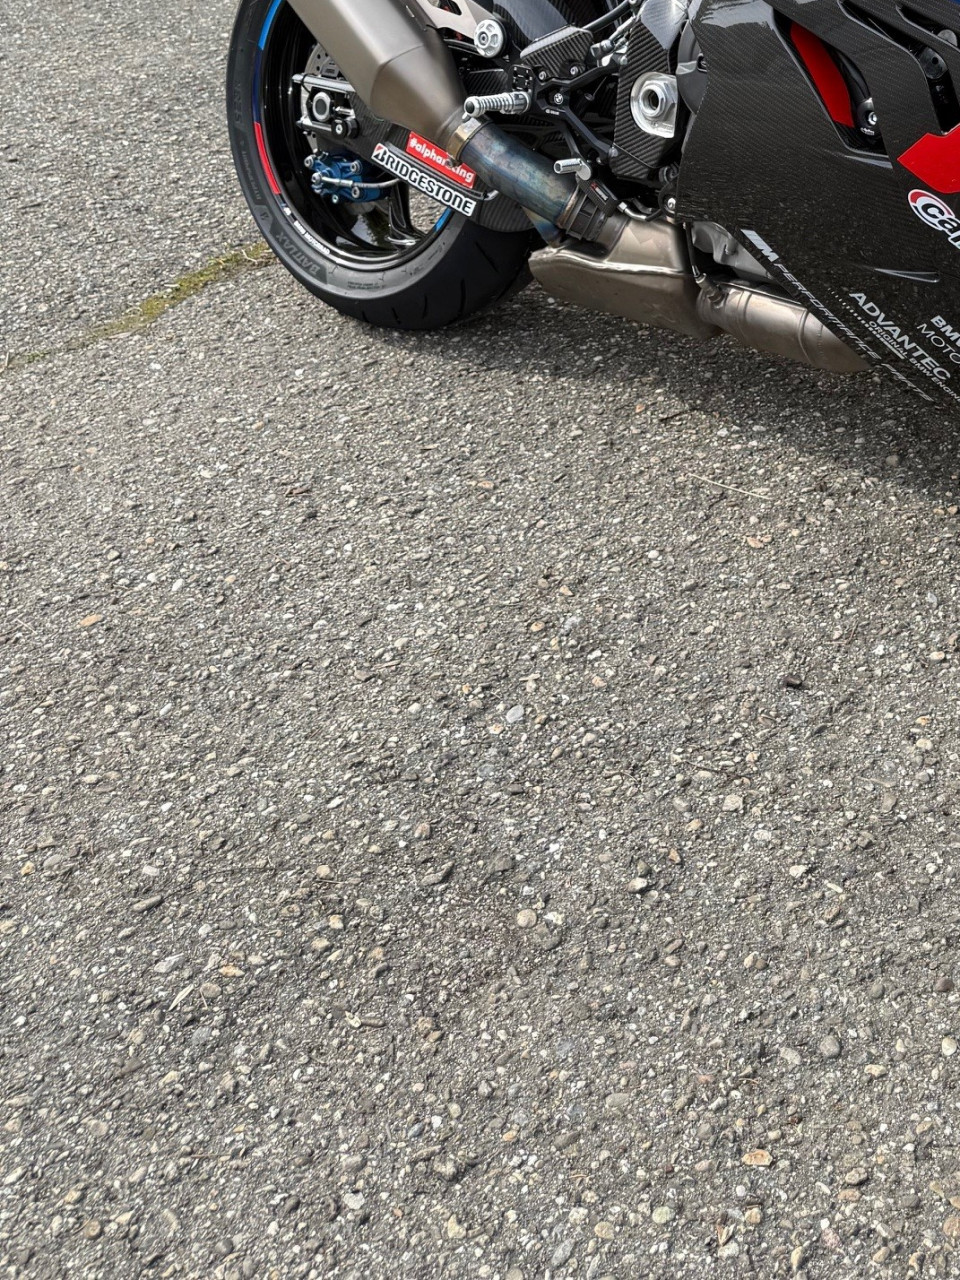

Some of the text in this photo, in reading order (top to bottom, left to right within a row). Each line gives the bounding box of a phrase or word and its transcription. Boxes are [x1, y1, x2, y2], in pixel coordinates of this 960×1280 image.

[373, 144, 474, 216] BRIDGESTONE
[409, 137, 475, 183] #alpharing
[773, 263, 882, 360] PERFORMANCE
[881, 363, 934, 401] PARTS
[849, 292, 951, 380] ADVANTEC
[868, 321, 908, 357] ORIGINAL
[909, 357, 933, 377] BMW
